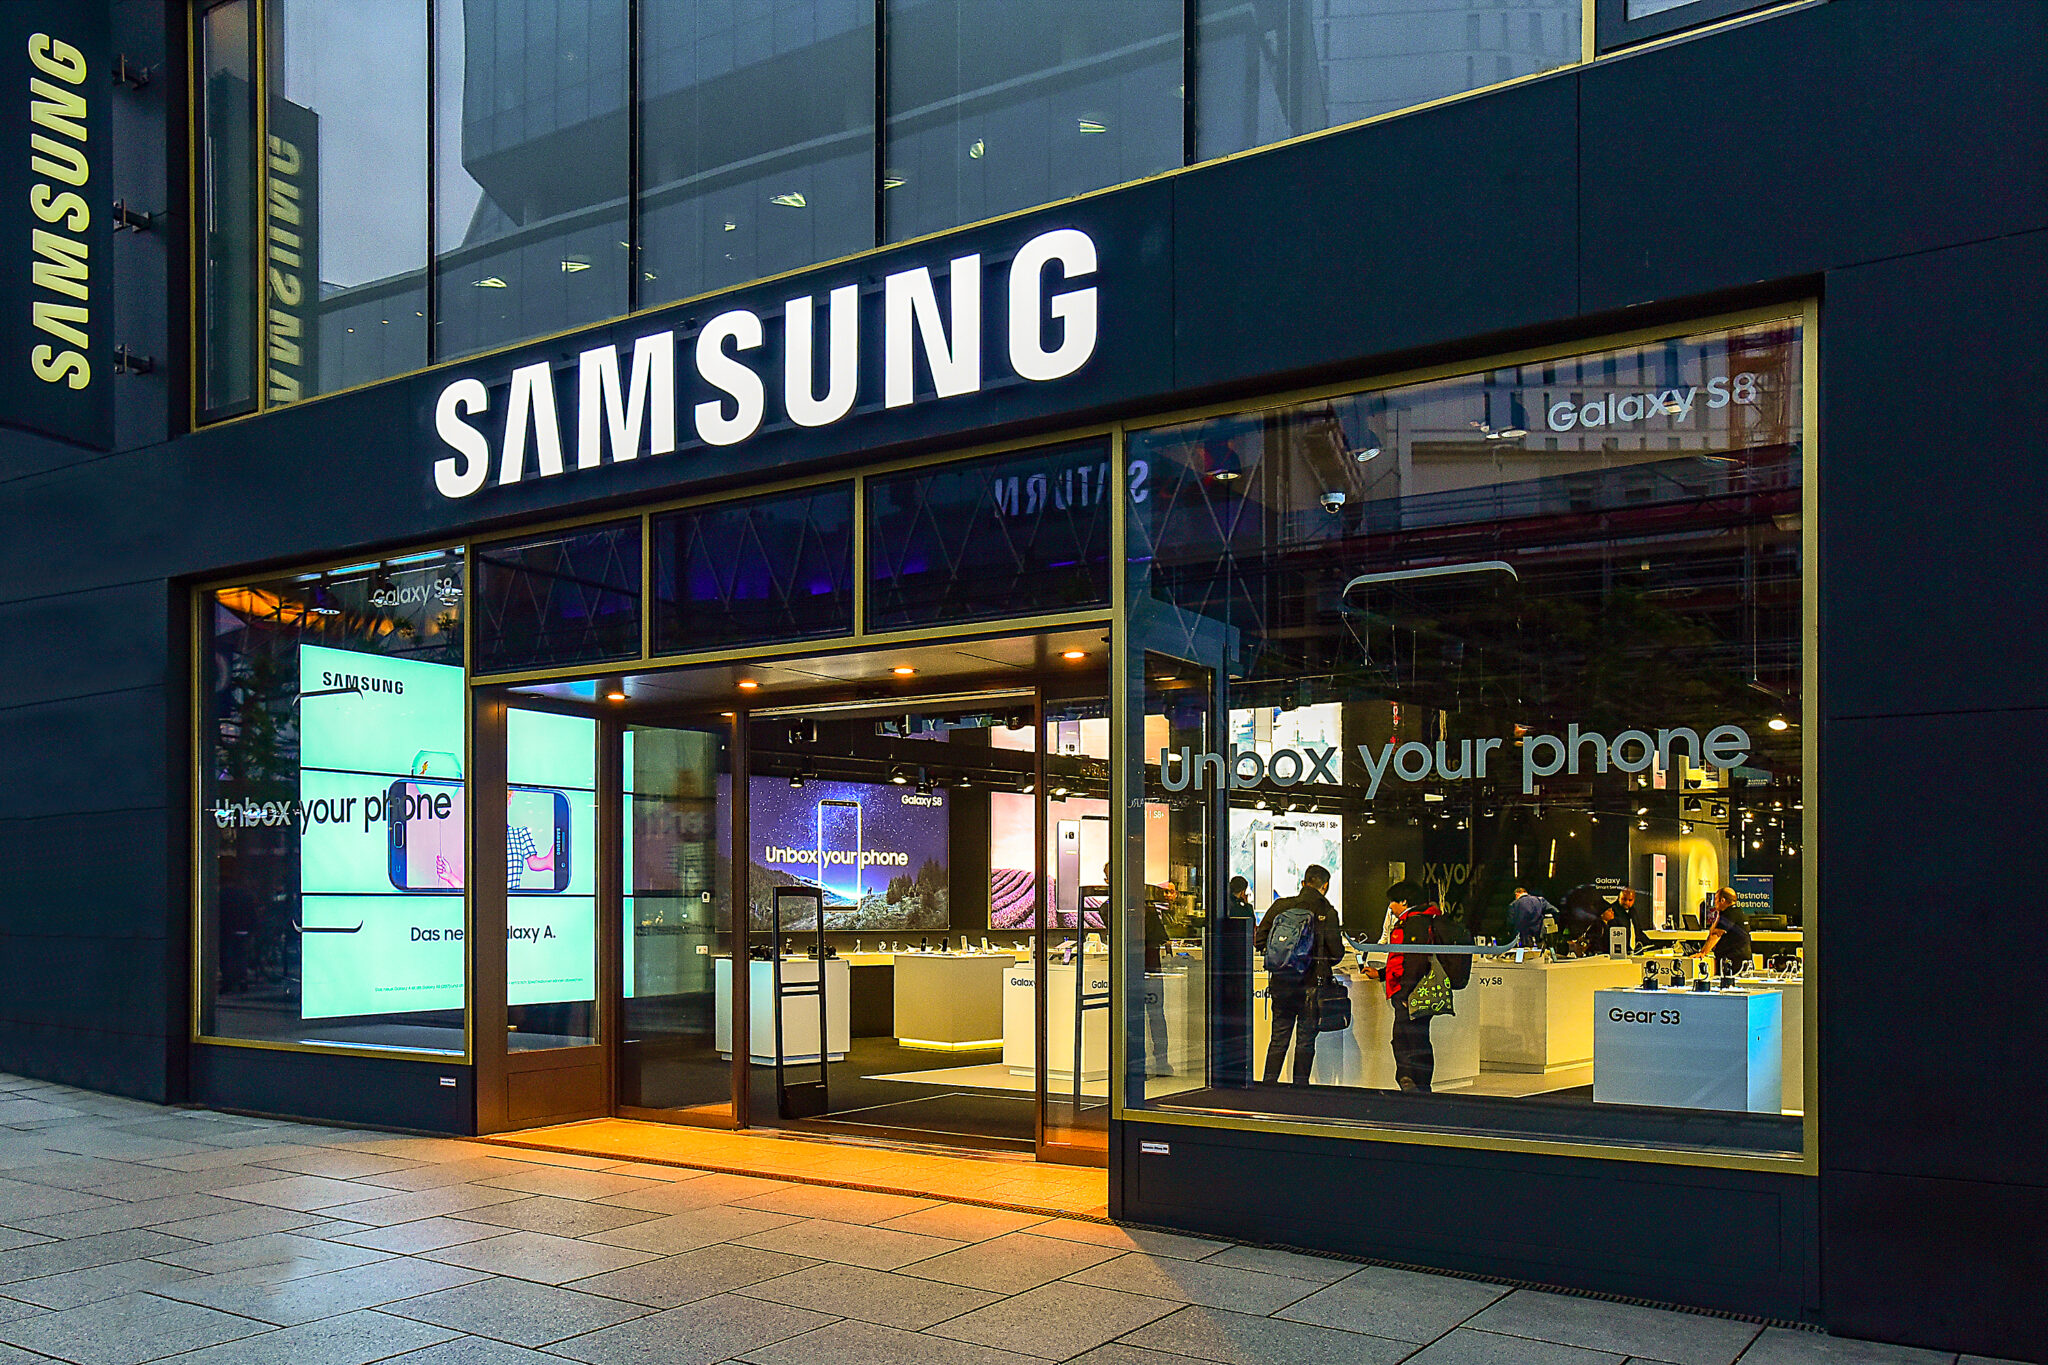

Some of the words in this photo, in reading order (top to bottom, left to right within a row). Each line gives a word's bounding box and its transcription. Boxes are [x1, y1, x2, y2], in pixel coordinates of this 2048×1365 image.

[28, 33, 91, 390] SAMSUNG
[433, 228, 1098, 498] SAMSUNG
[1547, 385, 1697, 432] Galaxy
[1706, 372, 1758, 409] S8
[373, 584, 431, 608] Galaxy
[433, 577, 453, 599] S8
[322, 671, 404, 695] SAMSUNG
[1160, 742, 1338, 792] Unbox
[1357, 736, 1503, 800] your
[1522, 723, 1751, 795] phone
[901, 794, 931, 808] Galaxy
[931, 796, 943, 807] S8
[215, 797, 292, 829] Unbox
[299, 797, 357, 836] your
[1299, 820, 1319, 829] Galaxy
[765, 846, 818, 864] Unbox
[822, 849, 857, 869] your
[860, 848, 909, 870] phone
[1595, 877, 1621, 885] Galaxy
[1737, 892, 1770, 900] Testnote:
[410, 926, 440, 942] Das
[506, 925, 540, 944] laxy
[544, 924, 556, 939] A.
[1491, 975, 1503, 986] S8
[1660, 967, 1670, 975] S3
[1608, 1006, 1656, 1024] Gear
[1659, 1008, 1681, 1025] S3
